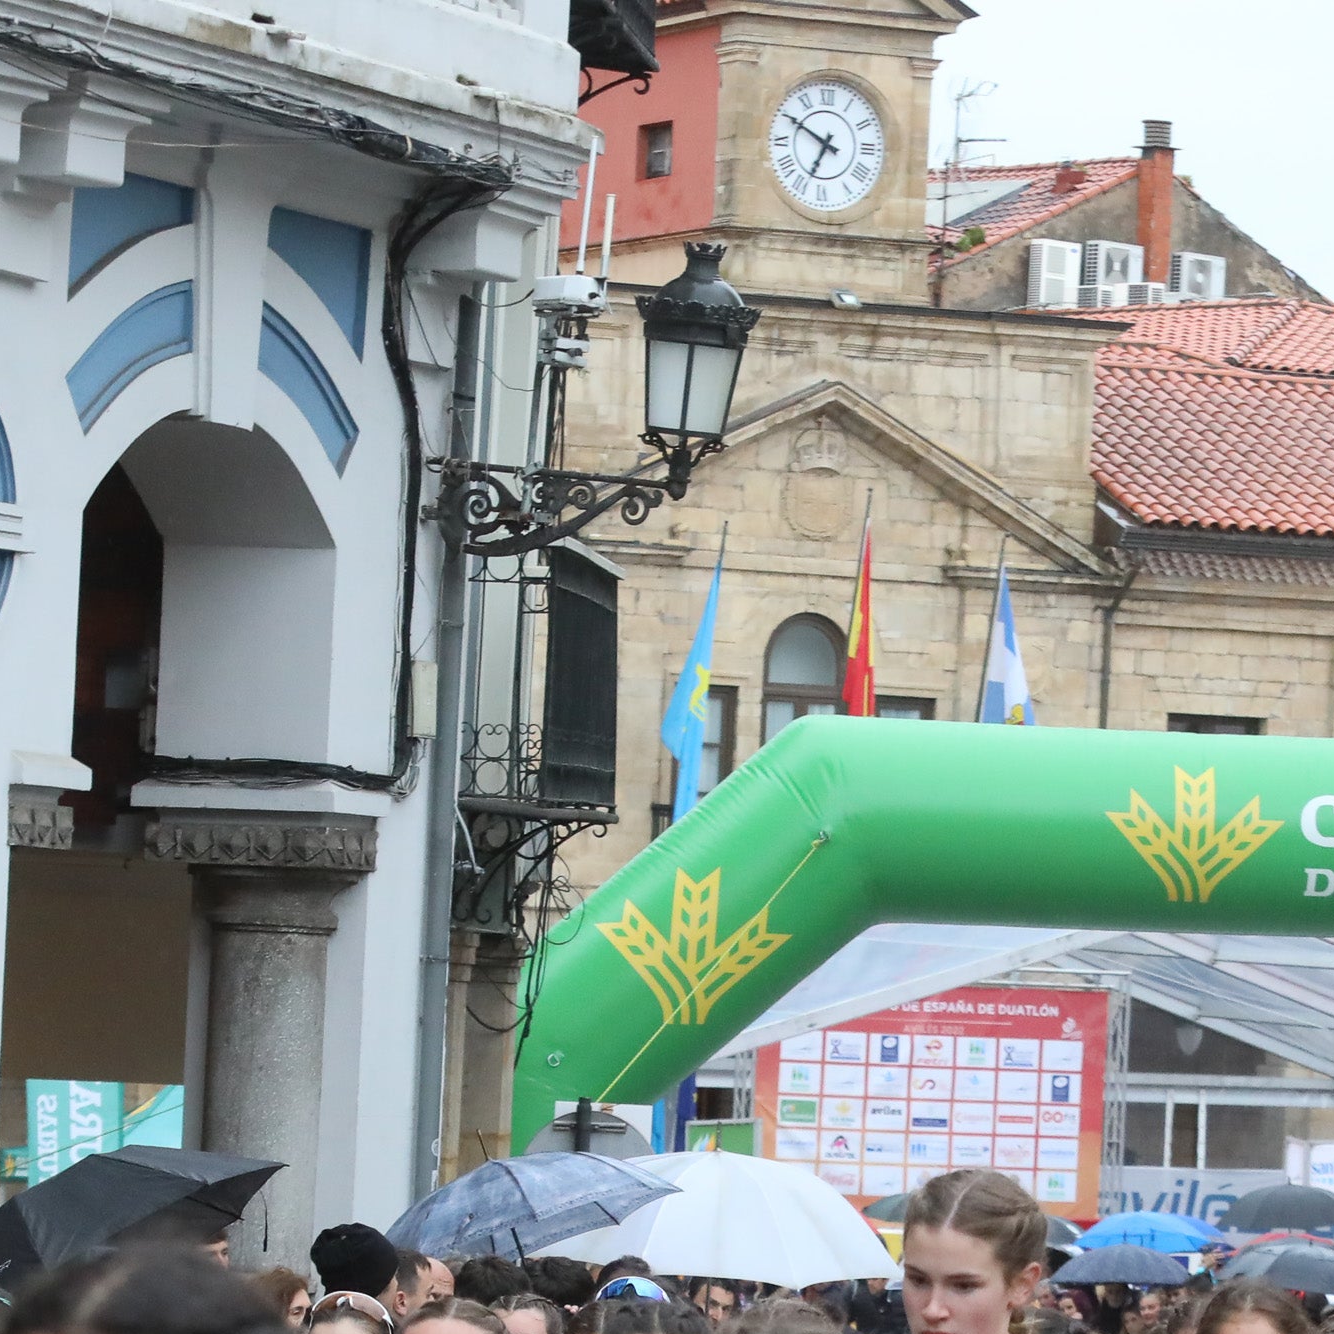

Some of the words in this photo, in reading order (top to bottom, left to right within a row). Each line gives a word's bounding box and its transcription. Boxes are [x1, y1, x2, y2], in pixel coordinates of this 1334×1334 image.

[923, 999, 974, 1014] ESPAÑA
[977, 1003, 996, 1016] DE
[998, 1003, 1060, 1018] DUATLÓN
